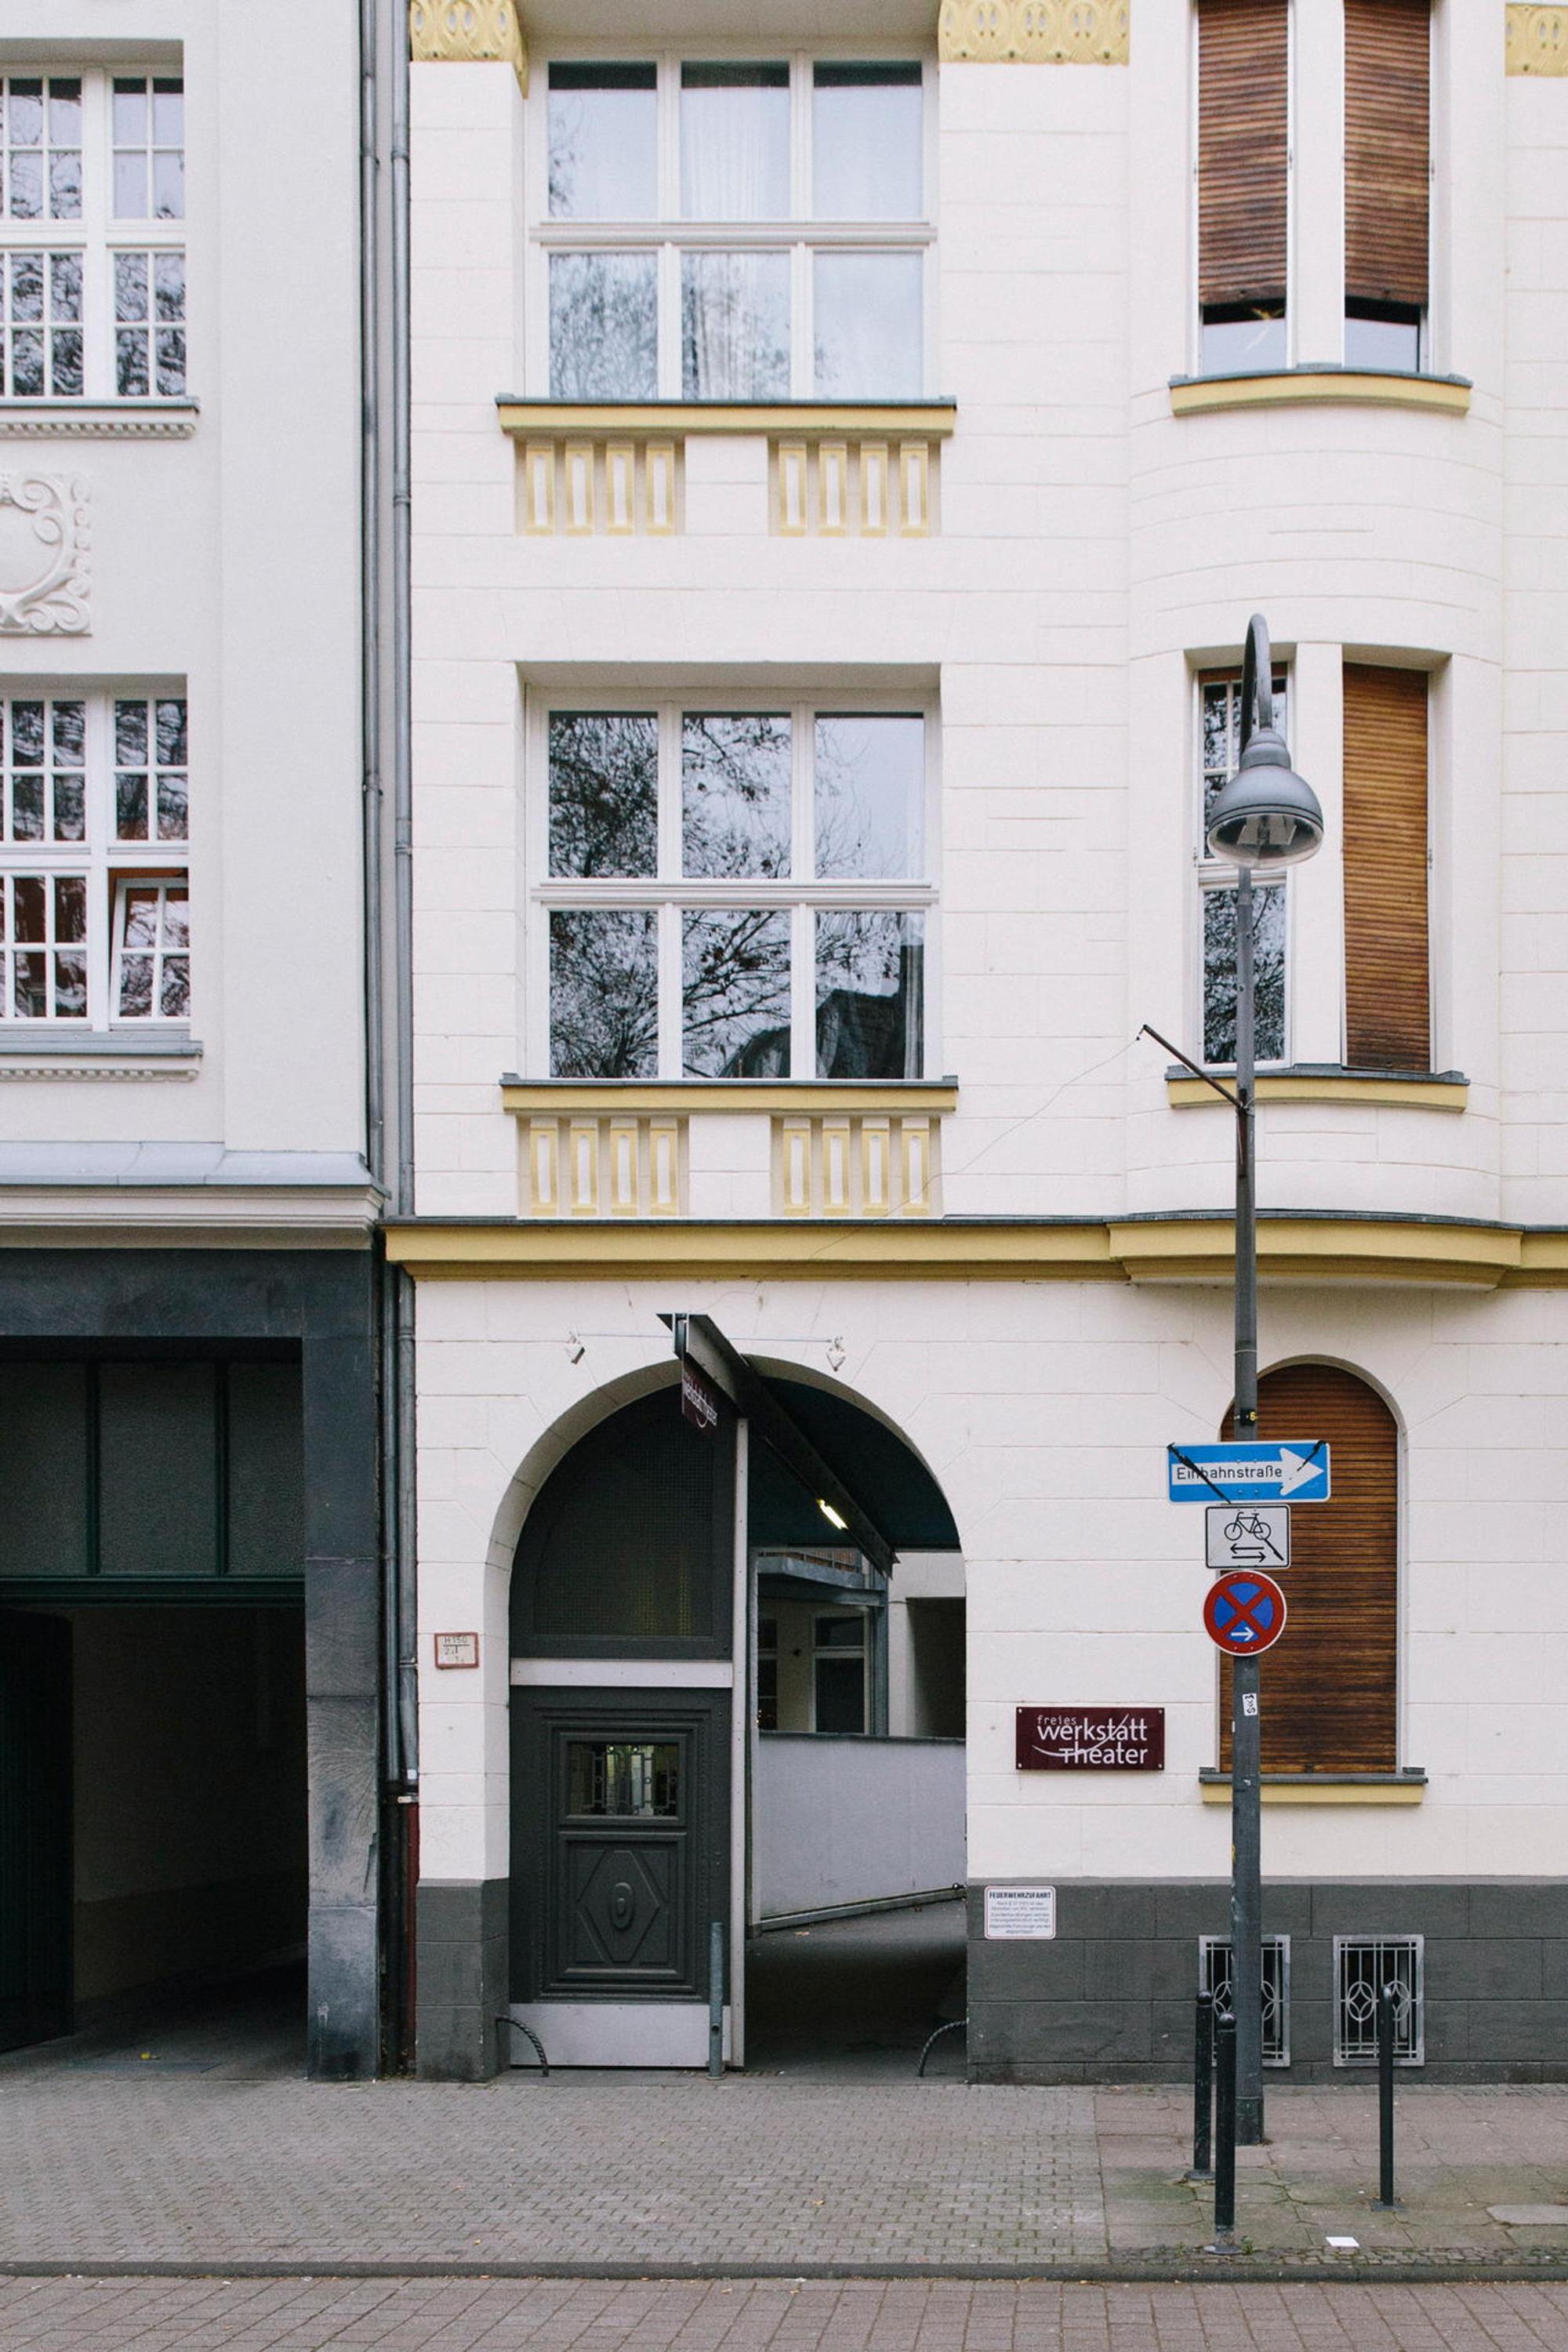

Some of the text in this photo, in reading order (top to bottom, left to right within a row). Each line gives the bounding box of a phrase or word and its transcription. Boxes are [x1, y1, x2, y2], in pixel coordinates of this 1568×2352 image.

[1177, 1465, 1283, 1479] Einbahnstraße
[1037, 1715, 1077, 1726] freies
[1037, 1718, 1147, 1740] werkstatt
